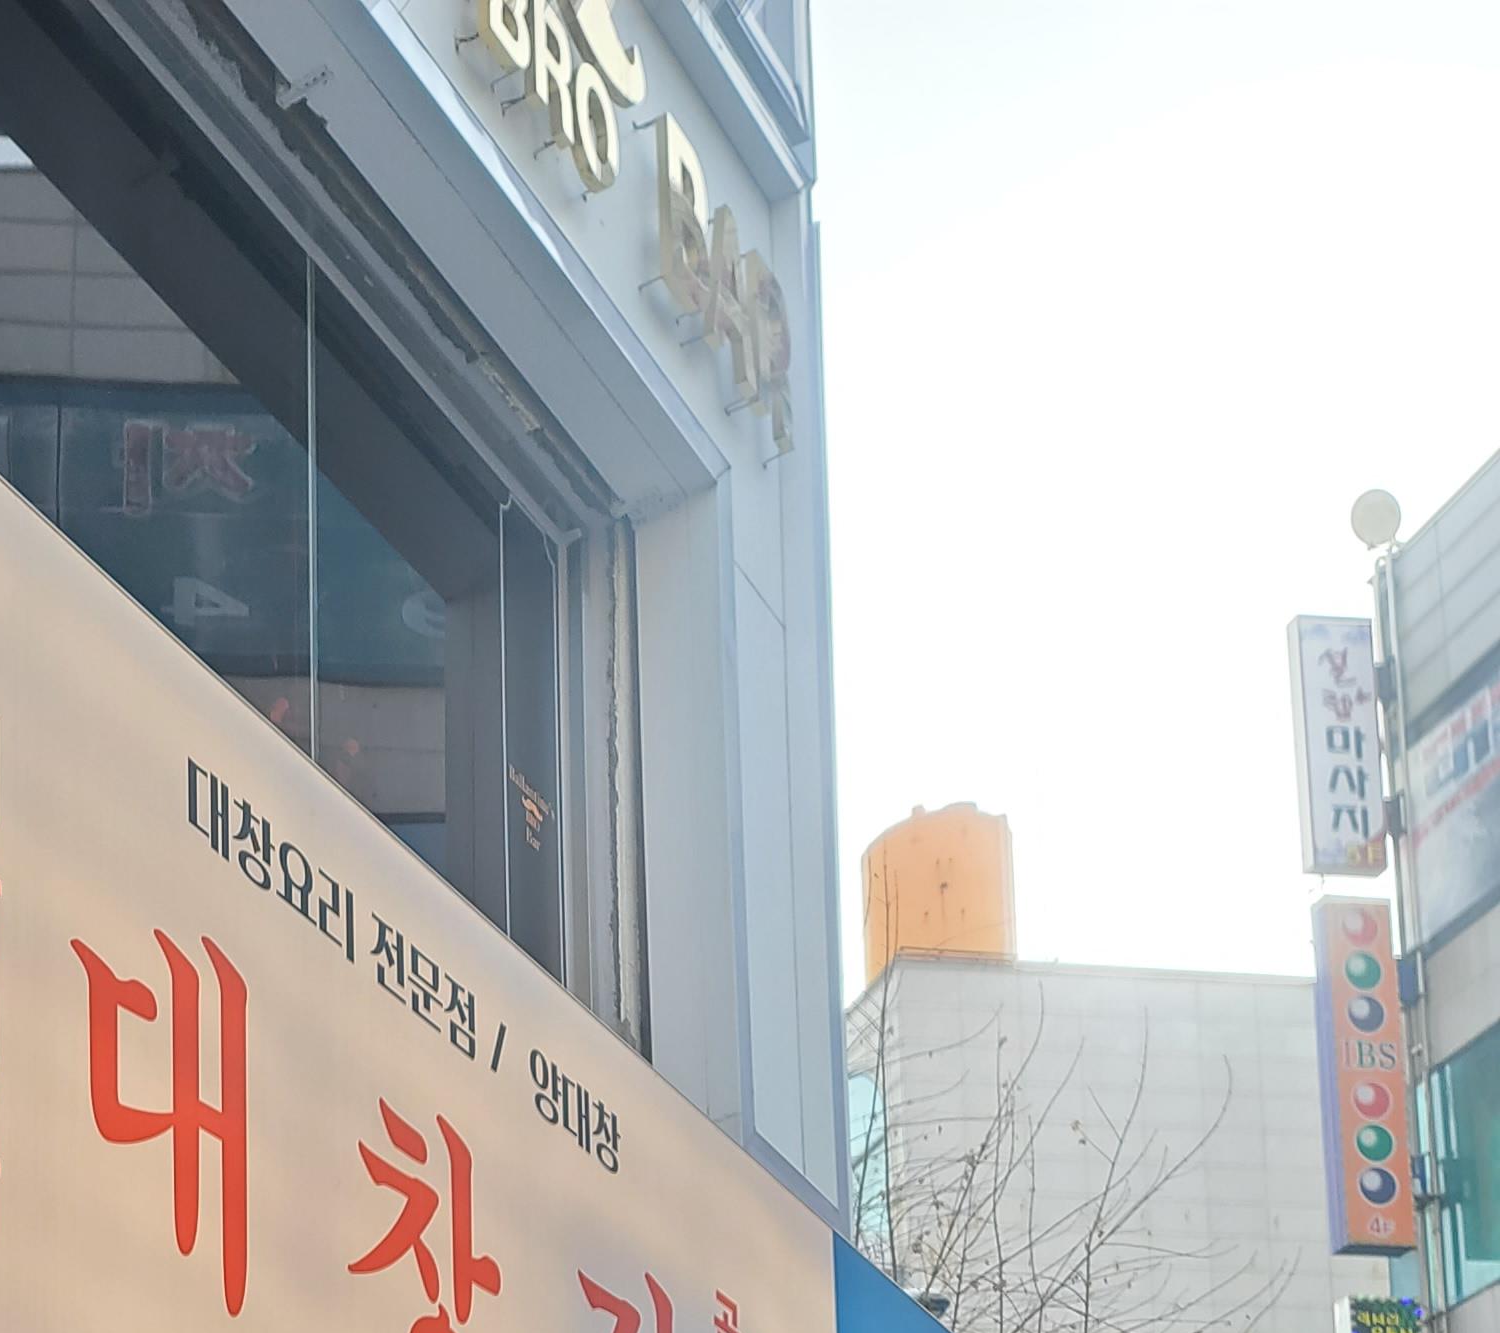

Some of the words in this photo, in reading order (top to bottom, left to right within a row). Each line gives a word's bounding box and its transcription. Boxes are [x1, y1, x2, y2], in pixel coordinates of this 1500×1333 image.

[1324, 724, 1369, 841] 마사지
[187, 756, 356, 963] 대창요리
[369, 911, 478, 1062] 전문점
[528, 1047, 622, 1176] 양대창
